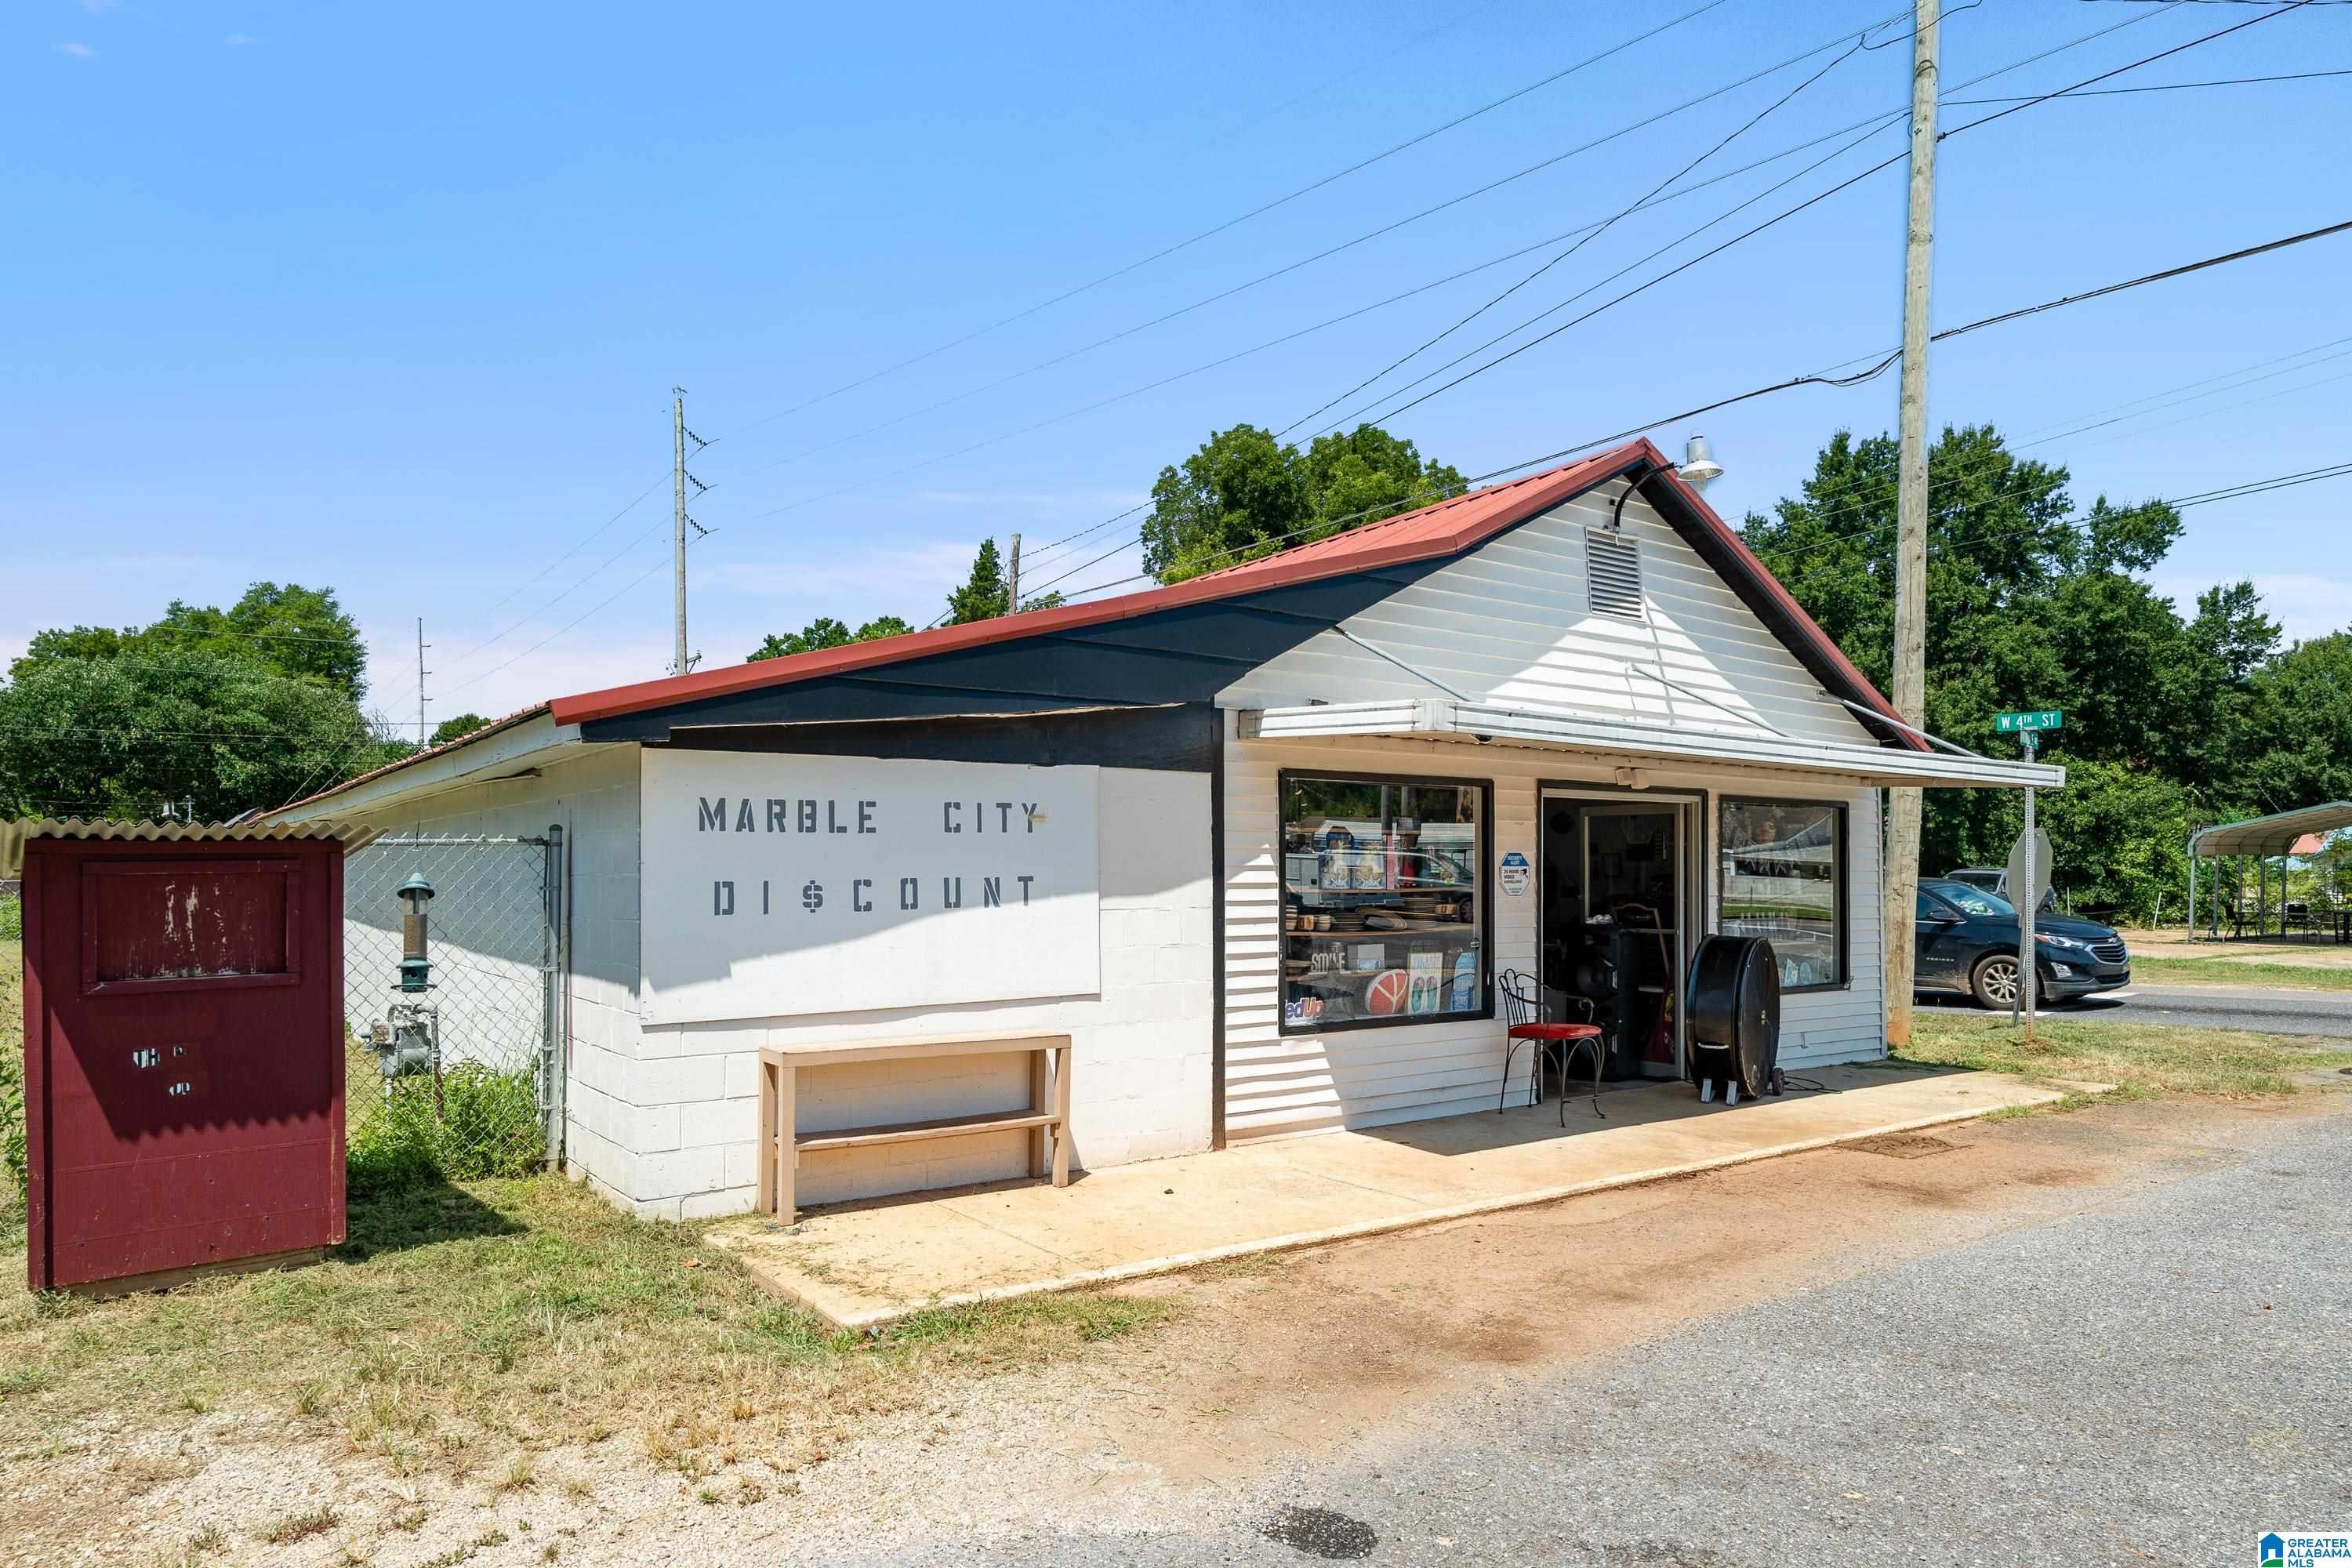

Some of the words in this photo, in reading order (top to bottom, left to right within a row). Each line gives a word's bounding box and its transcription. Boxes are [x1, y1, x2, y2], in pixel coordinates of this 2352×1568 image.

[2001, 716, 2011, 728] W
[2016, 715, 2032, 728] 4TH
[2042, 713, 2055, 726] ST
[699, 797, 877, 834] MARBLE
[943, 801, 1038, 833] CITY
[713, 876, 1035, 916] DI$COUNT
